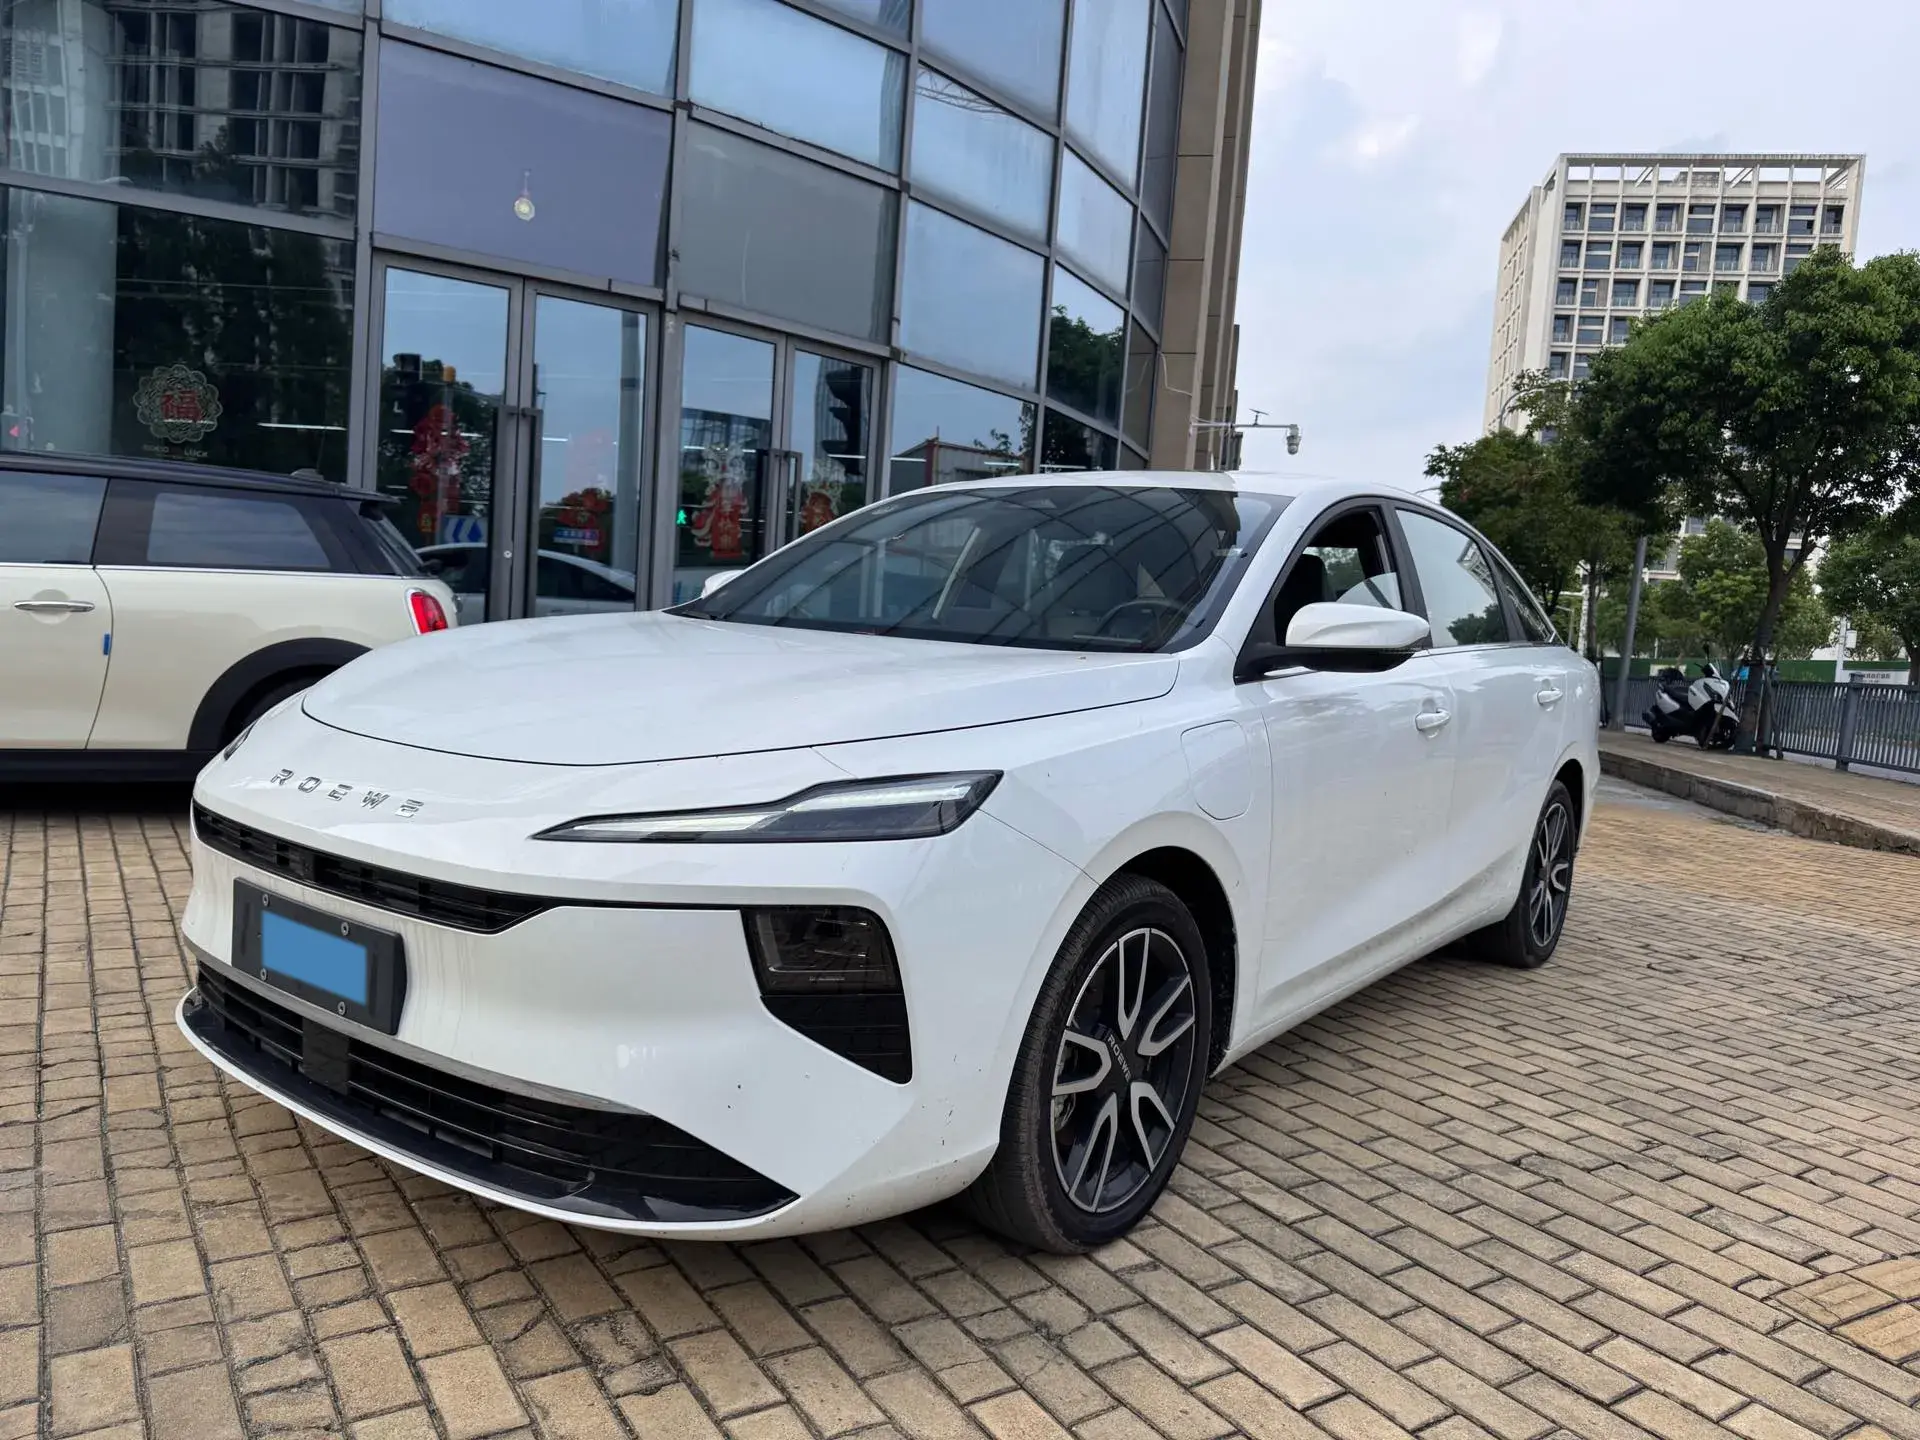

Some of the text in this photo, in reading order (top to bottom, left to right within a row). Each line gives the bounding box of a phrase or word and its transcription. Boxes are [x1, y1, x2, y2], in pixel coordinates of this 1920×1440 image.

[162, 389, 203, 421] 福
[184, 448, 208, 458] LUCK
[270, 768, 425, 818] ROEWE
[1107, 1034, 1131, 1082] ROEWE
